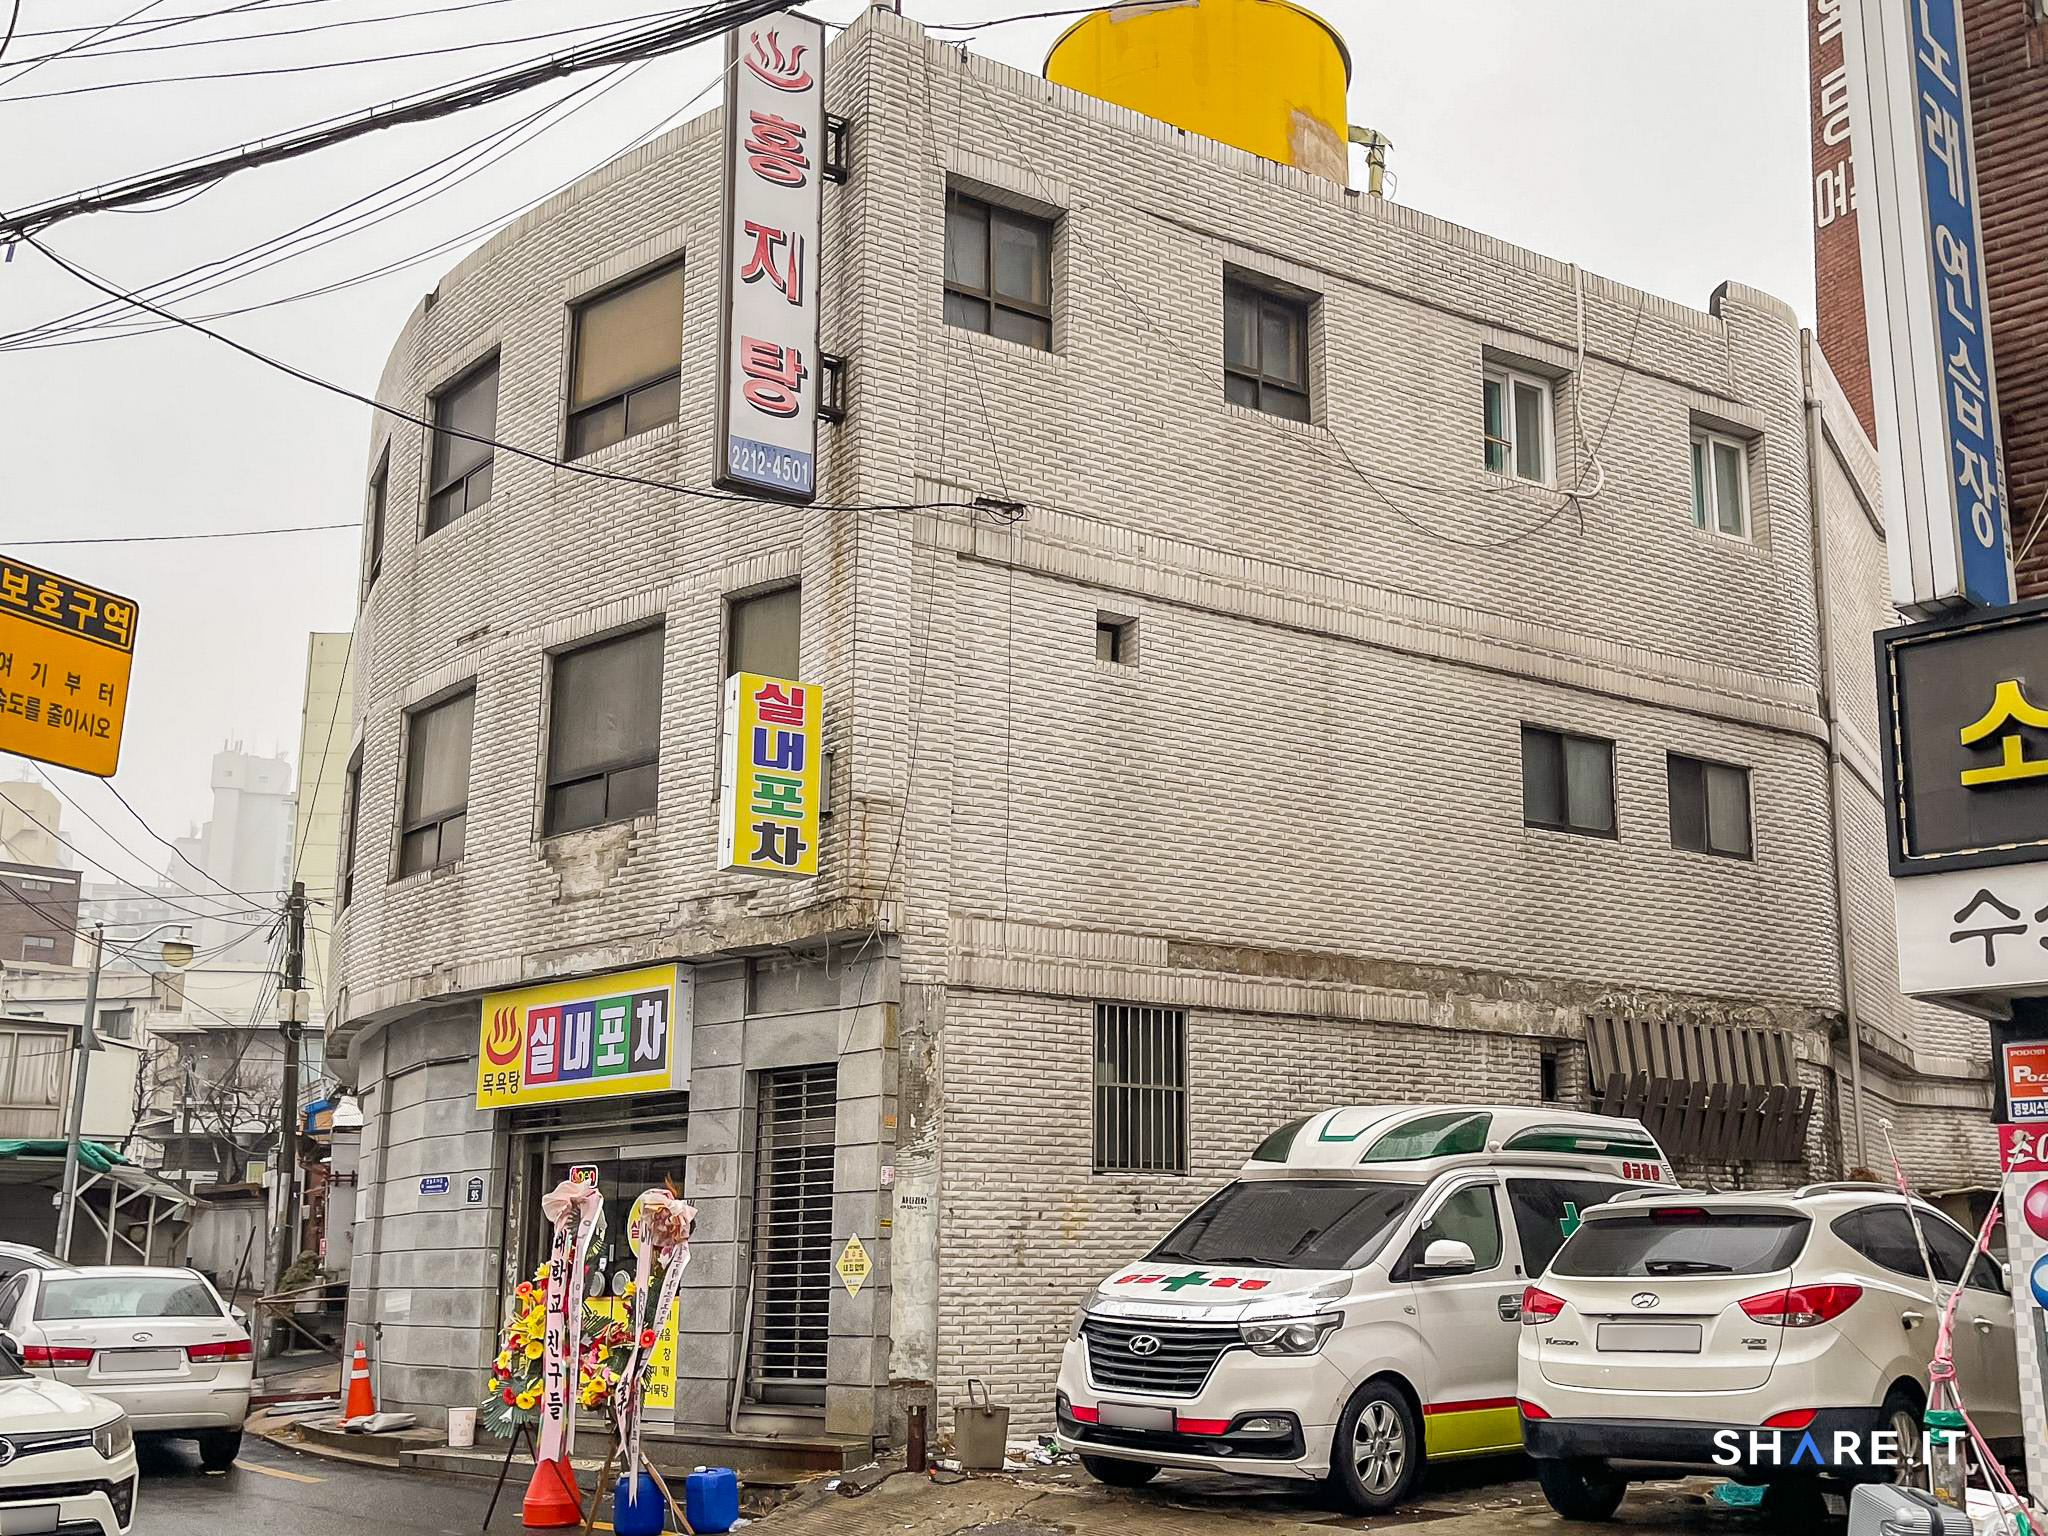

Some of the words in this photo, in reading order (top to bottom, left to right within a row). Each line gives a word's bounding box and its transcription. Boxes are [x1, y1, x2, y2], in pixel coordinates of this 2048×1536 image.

[741, 109, 808, 419] 홍지탕
[732, 445, 807, 485] 2212-4501
[0, 567, 130, 644] 보호구역
[47, 702, 110, 739] 줄이시오
[751, 683, 807, 866] 실내포차
[530, 999, 665, 1076] 실내포차
[483, 1070, 520, 1096] 목욕탕
[471, 1190, 479, 1200] 95
[547, 1329, 563, 1420] 친구들
